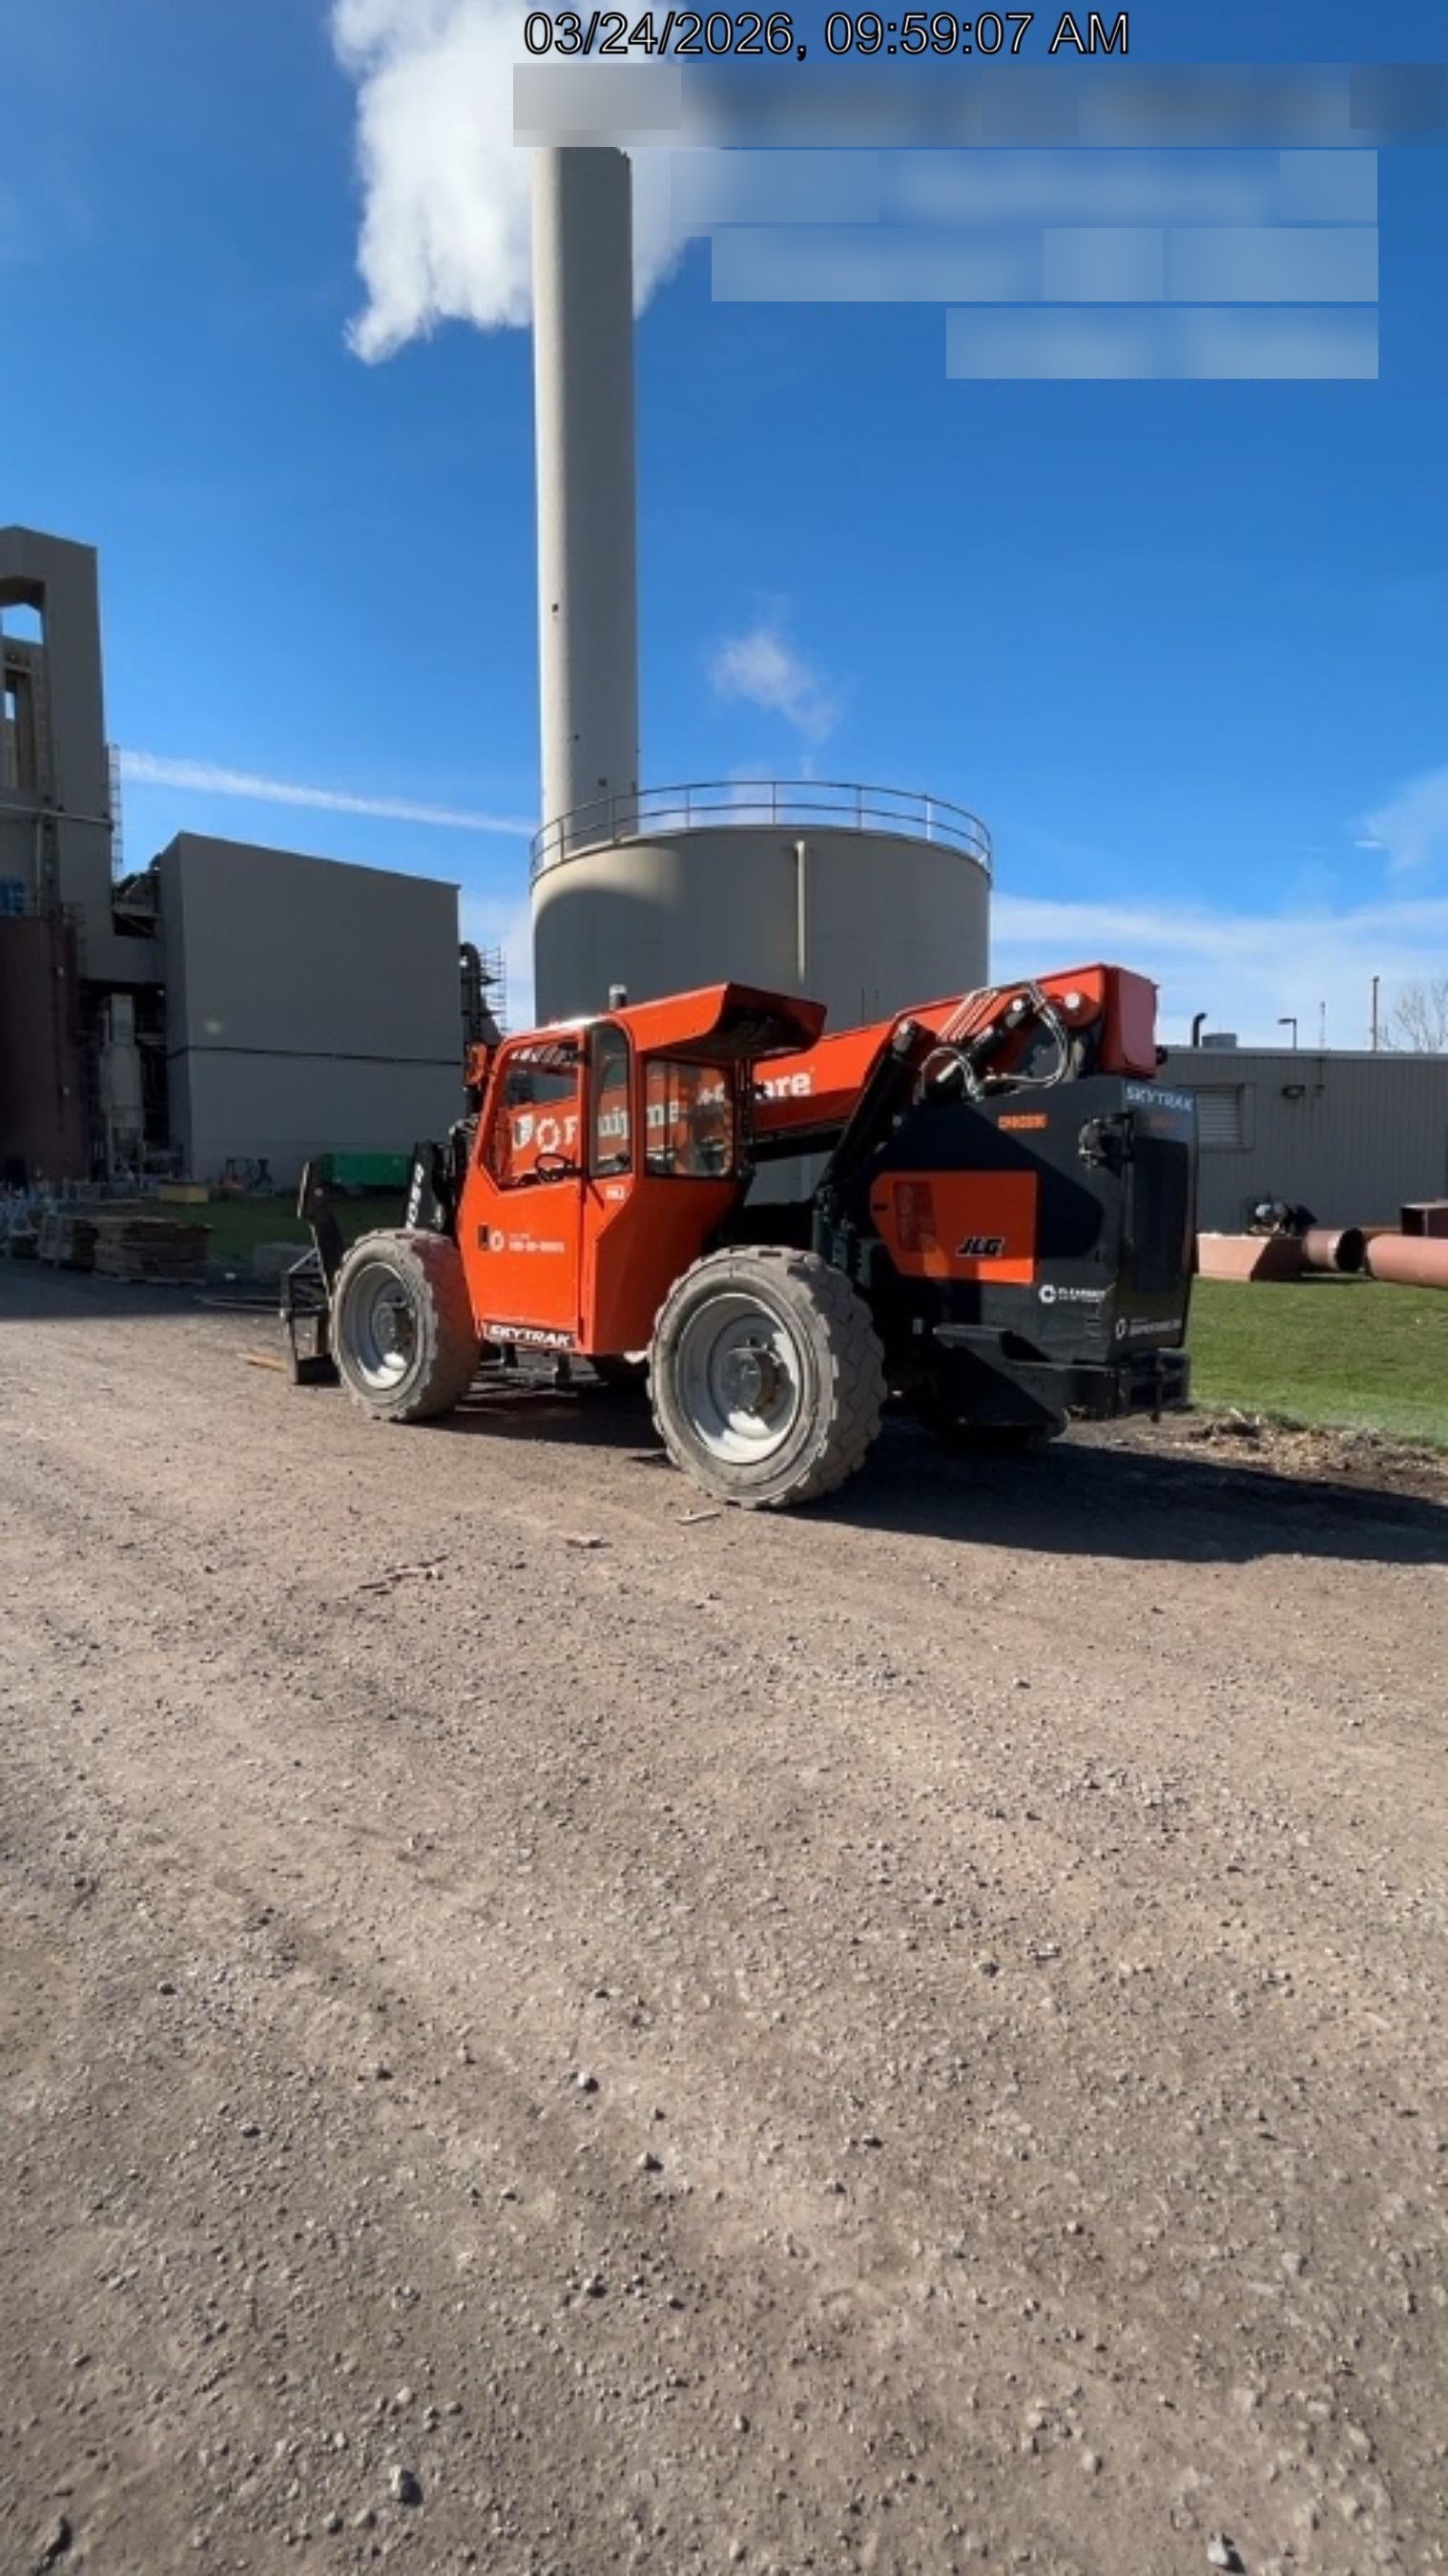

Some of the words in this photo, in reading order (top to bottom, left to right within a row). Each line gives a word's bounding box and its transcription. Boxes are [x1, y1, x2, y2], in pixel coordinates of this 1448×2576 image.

[1127, 1086, 1193, 1112] SKYTRAK
[956, 1236, 1005, 1257] JLG
[488, 1323, 572, 1347] SKYTRAK
